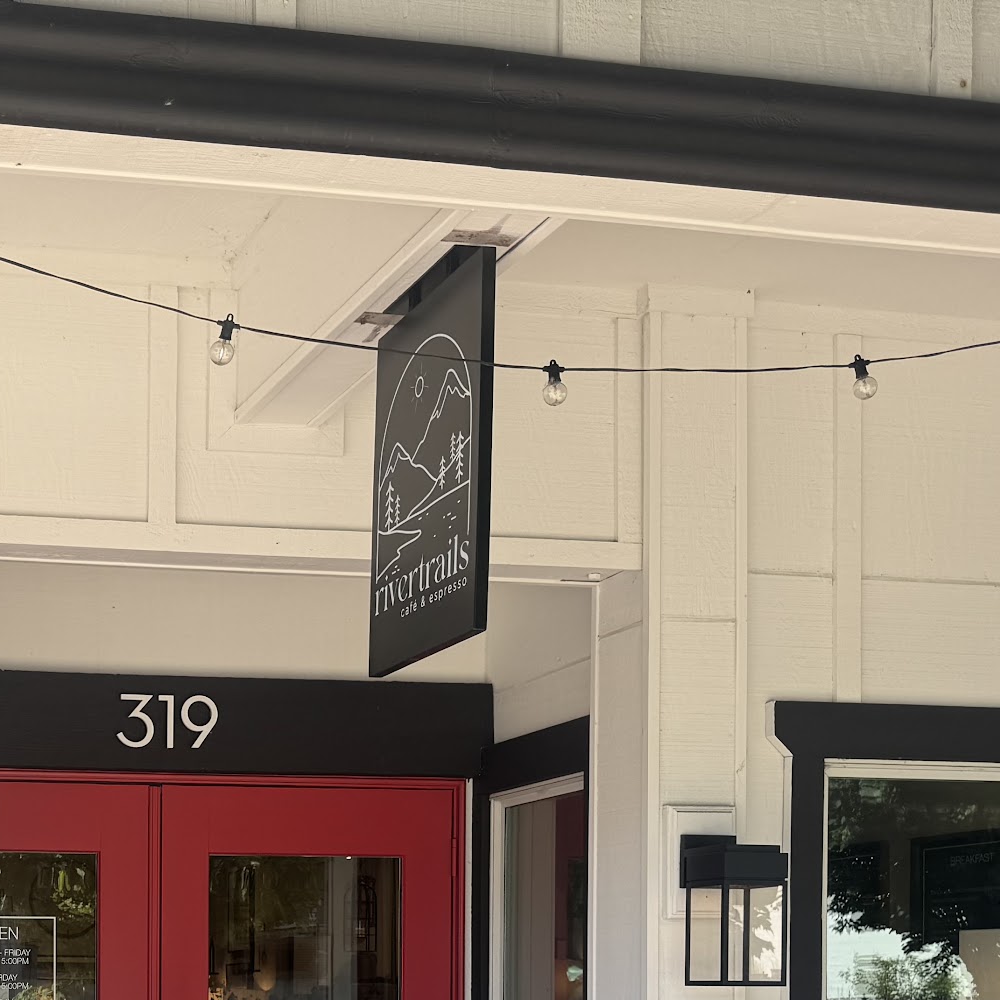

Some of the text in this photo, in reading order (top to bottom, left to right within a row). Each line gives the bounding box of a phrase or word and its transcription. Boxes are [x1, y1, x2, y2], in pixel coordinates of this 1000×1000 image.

[375, 534, 470, 616] rivertrails
[400, 576, 467, 618] café & espresso
[116, 693, 219, 749] 319
[1, 957, 30, 965] 5:00PM
[1, 982, 29, 990] 5:00PM
